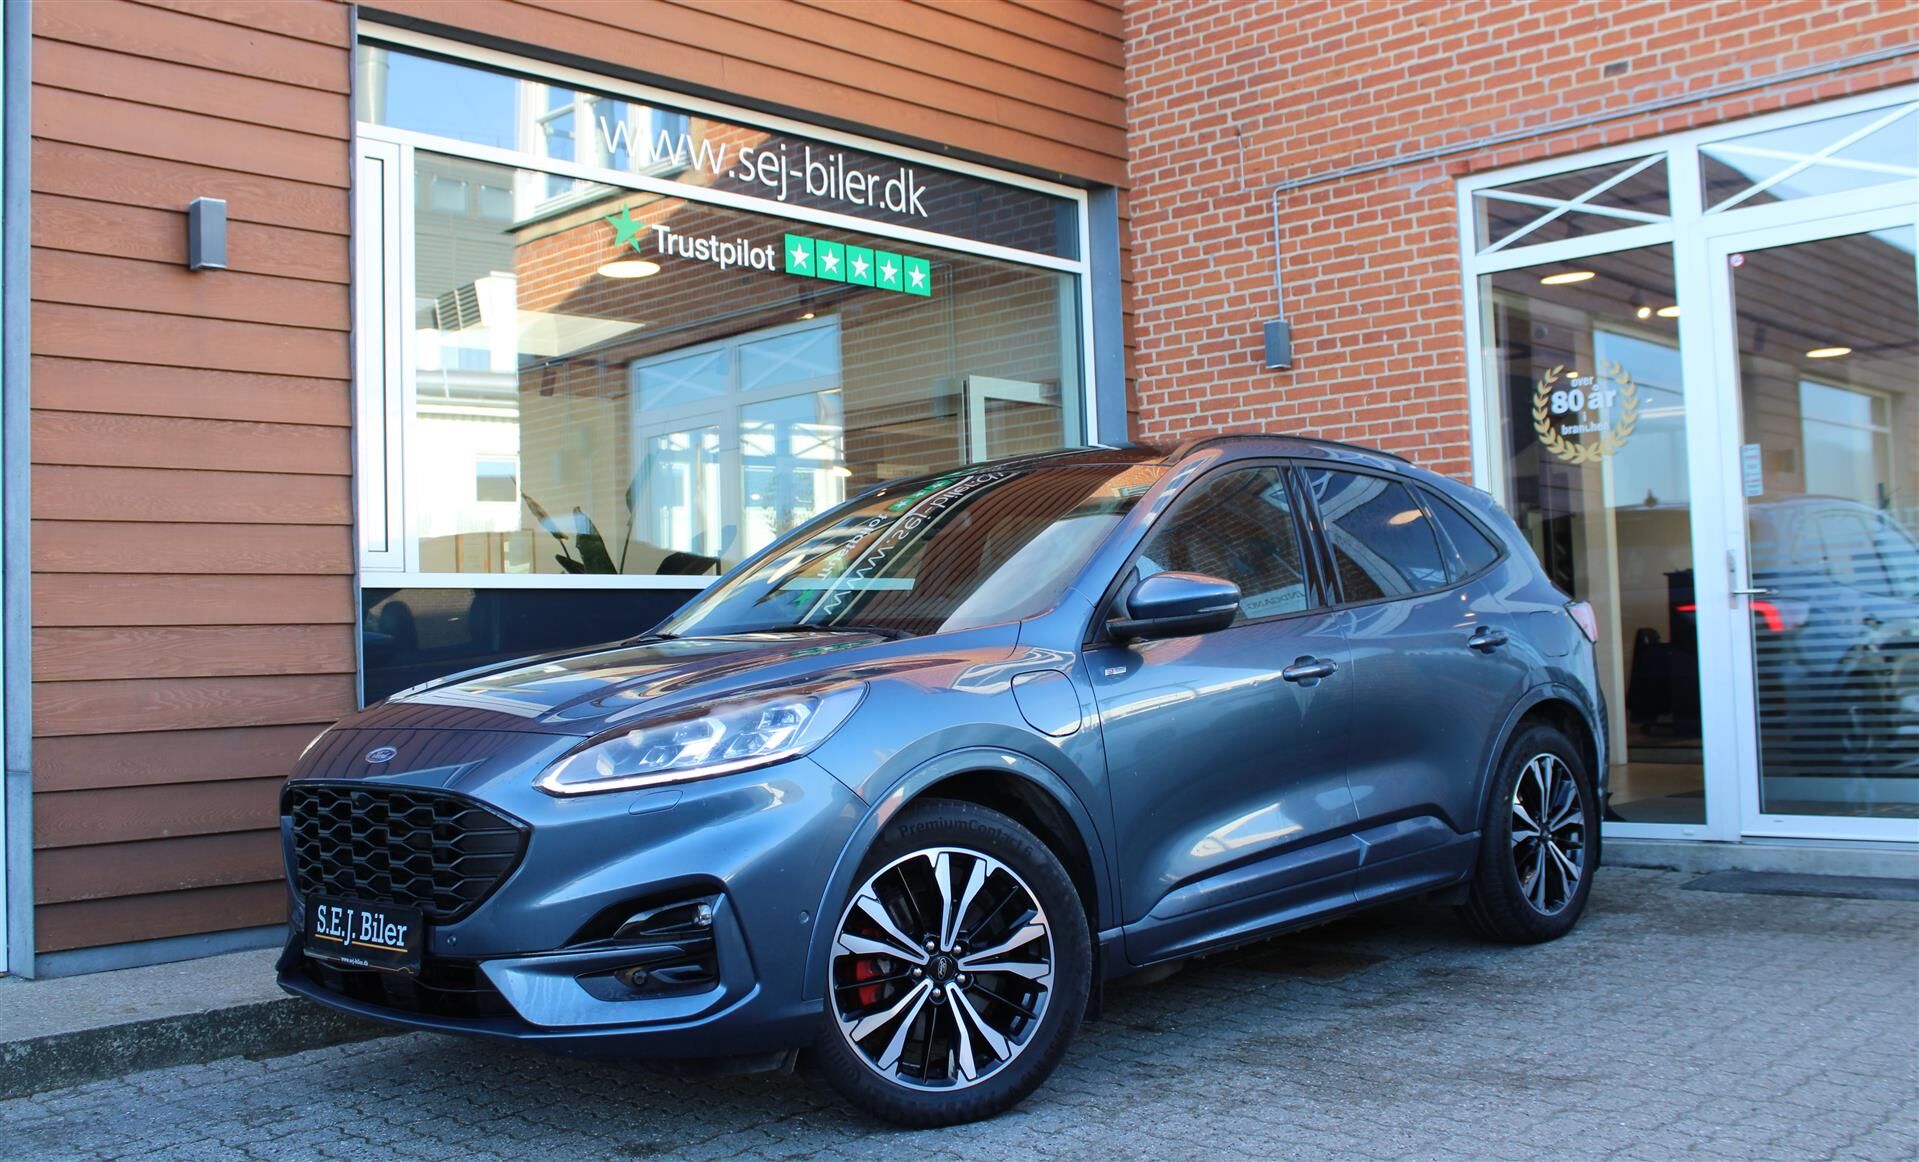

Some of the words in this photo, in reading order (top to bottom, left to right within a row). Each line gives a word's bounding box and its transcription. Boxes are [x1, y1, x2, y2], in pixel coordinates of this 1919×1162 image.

[600, 115, 928, 218] www.sej-biler.dk
[651, 223, 776, 271] Trustpilot
[1551, 389, 1584, 414] 80
[1587, 384, 1616, 410] år
[1570, 376, 1594, 387] over
[898, 816, 1023, 852] PremiumContact
[1024, 845, 1033, 858] 6
[316, 904, 356, 946] S.E.J.
[359, 911, 408, 947] Biler
